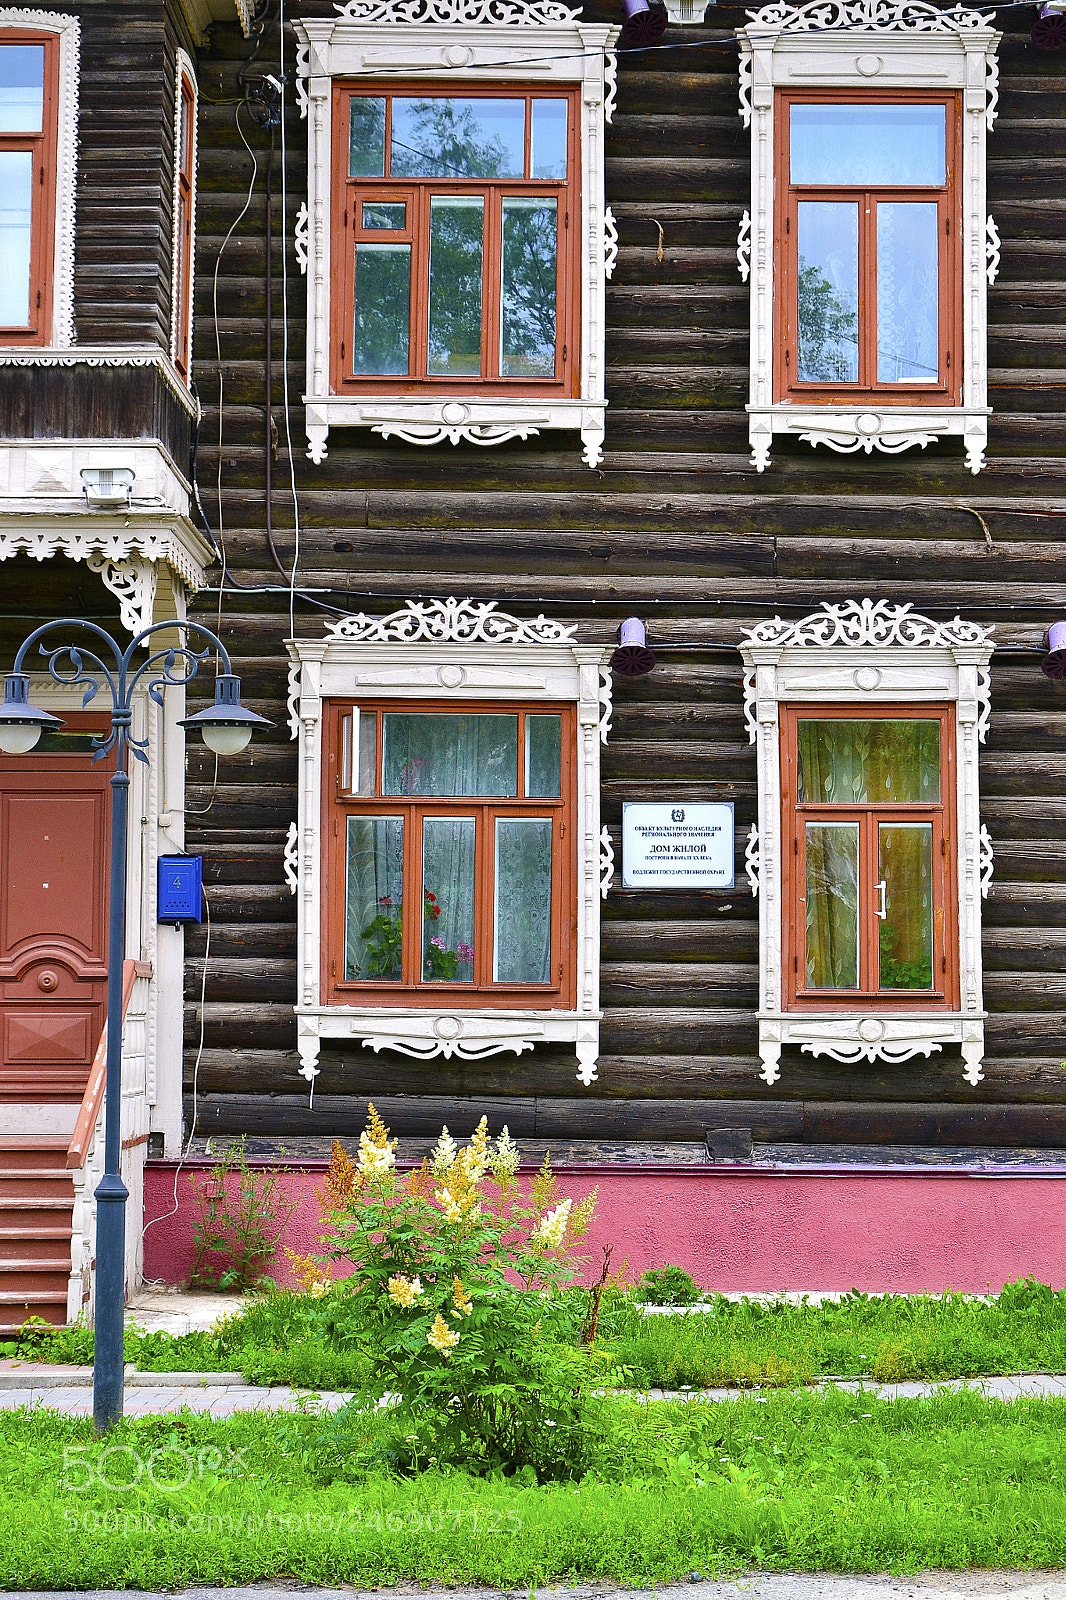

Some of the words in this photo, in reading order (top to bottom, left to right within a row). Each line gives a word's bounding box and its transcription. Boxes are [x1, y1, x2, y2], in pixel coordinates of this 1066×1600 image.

[650, 845, 671, 853] ДОМ
[672, 844, 707, 853] ЖИЛОЙ
[173, 876, 181, 888] 4
